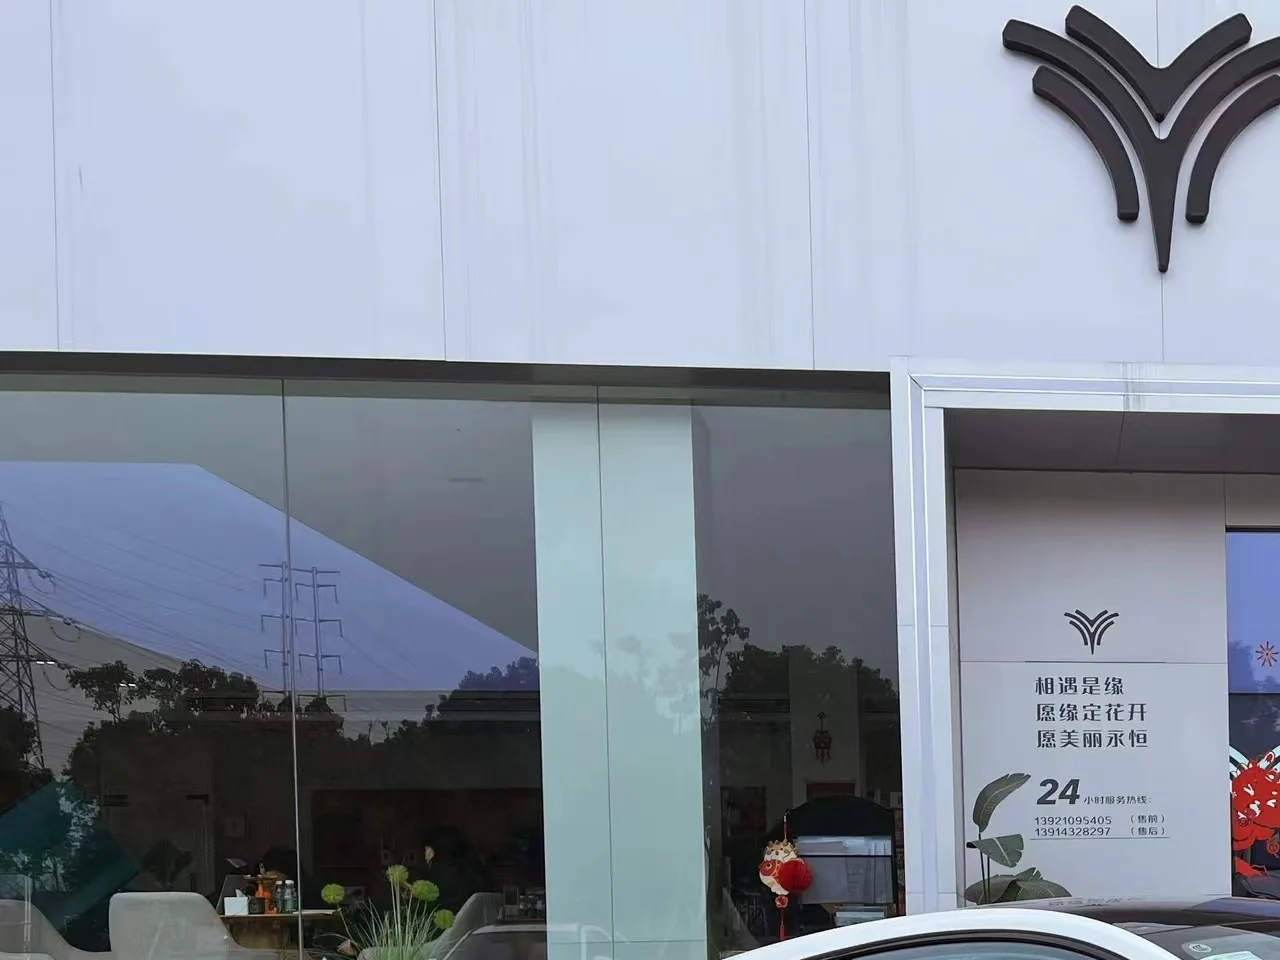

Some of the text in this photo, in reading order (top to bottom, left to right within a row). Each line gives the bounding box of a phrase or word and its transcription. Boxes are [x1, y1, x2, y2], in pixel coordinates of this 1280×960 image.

[1035, 676, 1124, 695] 相遇是缘
[1036, 703, 1147, 722] 愿缘定花开
[1037, 729, 1149, 748] 愿美丽永恒
[1034, 816, 1112, 826] 13921095405
[1034, 827, 1111, 837] 13914328297
